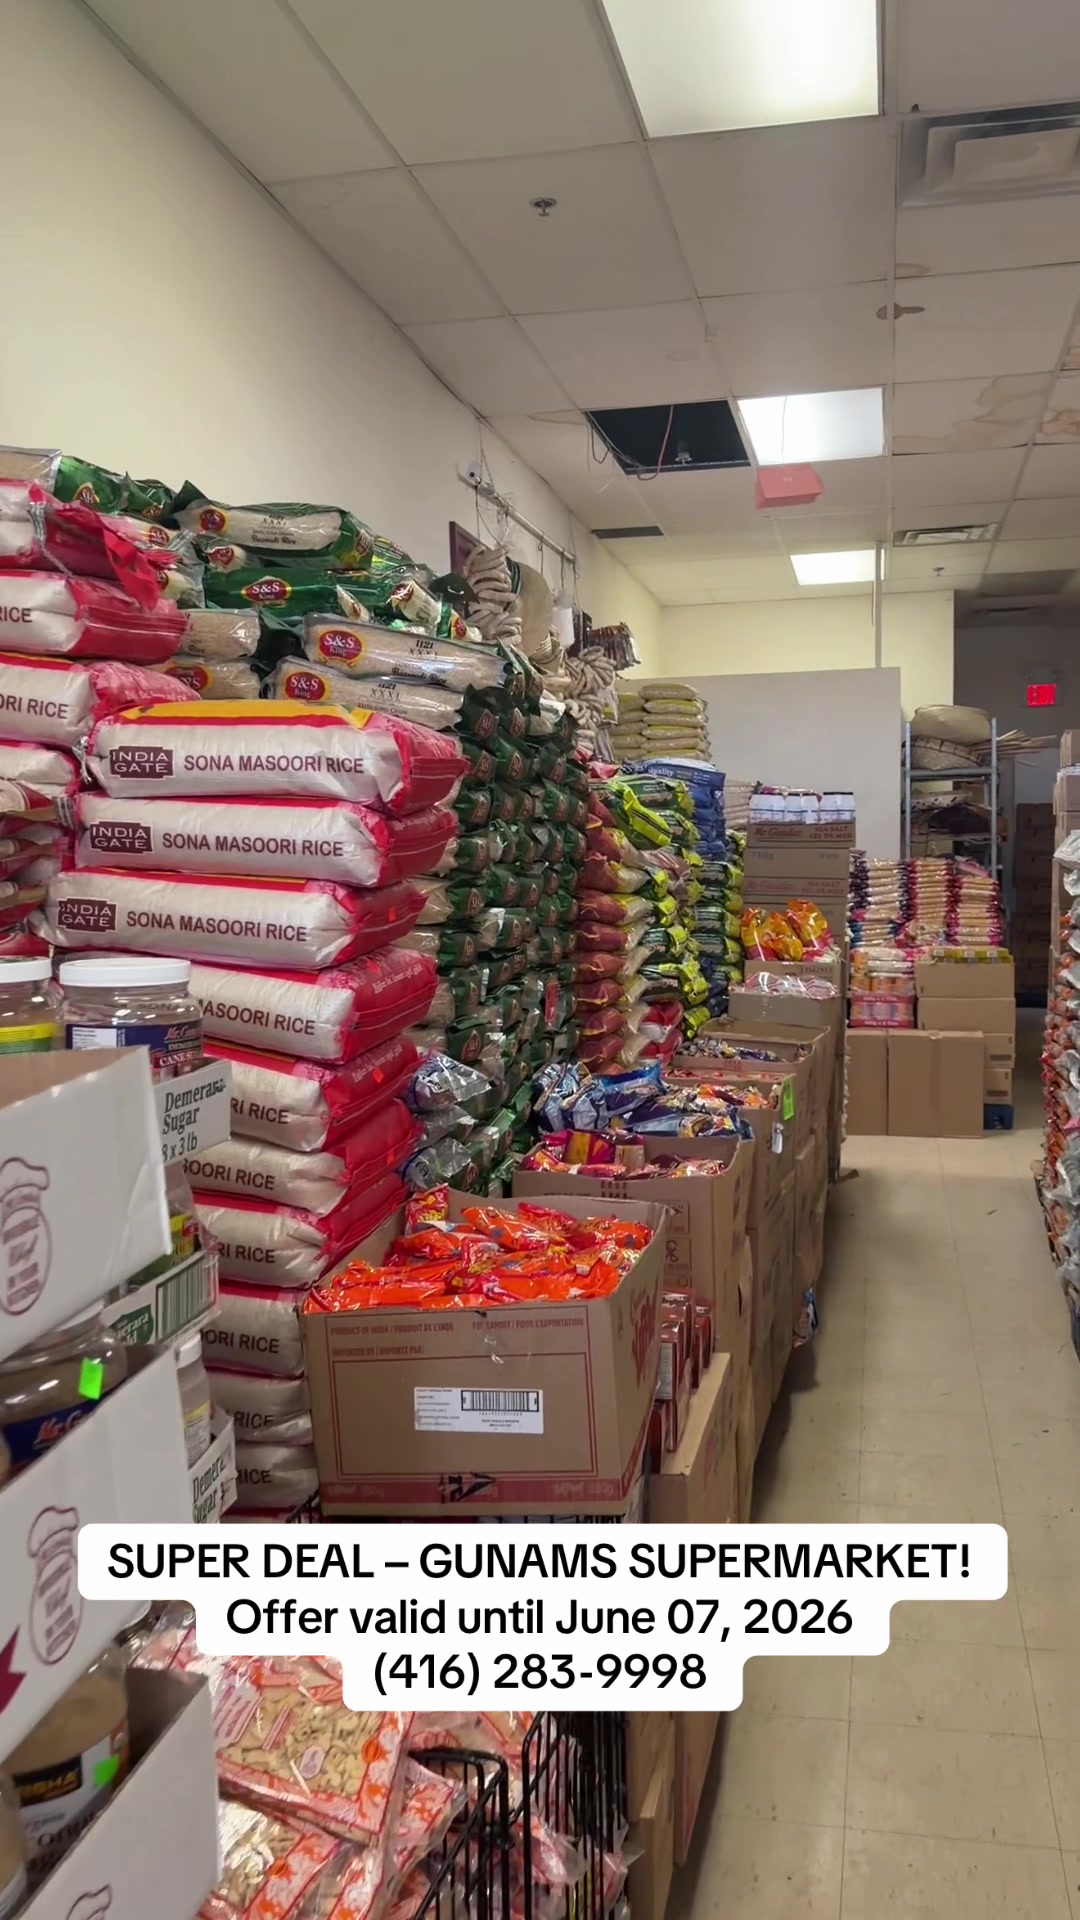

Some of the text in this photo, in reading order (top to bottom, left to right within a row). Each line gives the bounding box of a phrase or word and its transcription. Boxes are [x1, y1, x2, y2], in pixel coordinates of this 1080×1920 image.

[252, 581, 281, 594] S&S
[0, 606, 33, 623] ICE
[324, 633, 356, 649] S&S
[290, 676, 320, 691] S&S
[27, 697, 69, 720] RICE
[112, 751, 169, 762] INDIA
[184, 755, 364, 774] SONA MASOORI RICE
[114, 762, 168, 773] GATE
[92, 826, 147, 839] INDIA
[94, 837, 147, 849] GATE
[162, 832, 344, 857] SONA MASOORI RICE
[61, 903, 112, 916] INDIA
[61, 914, 111, 927] GATE
[126, 910, 308, 942] SONA MASOORI RICE
[200, 999, 270, 1028] ASOORI
[274, 1014, 316, 1036] RICE
[162, 1107, 200, 1136] Sugar
[248, 1102, 290, 1125] RICE
[178, 1138, 185, 1156] 3
[187, 1131, 198, 1150] lb
[235, 1168, 276, 1191] RICE
[235, 1244, 276, 1264] RICE
[240, 1333, 280, 1354] RICE
[233, 1410, 275, 1429] RICE
